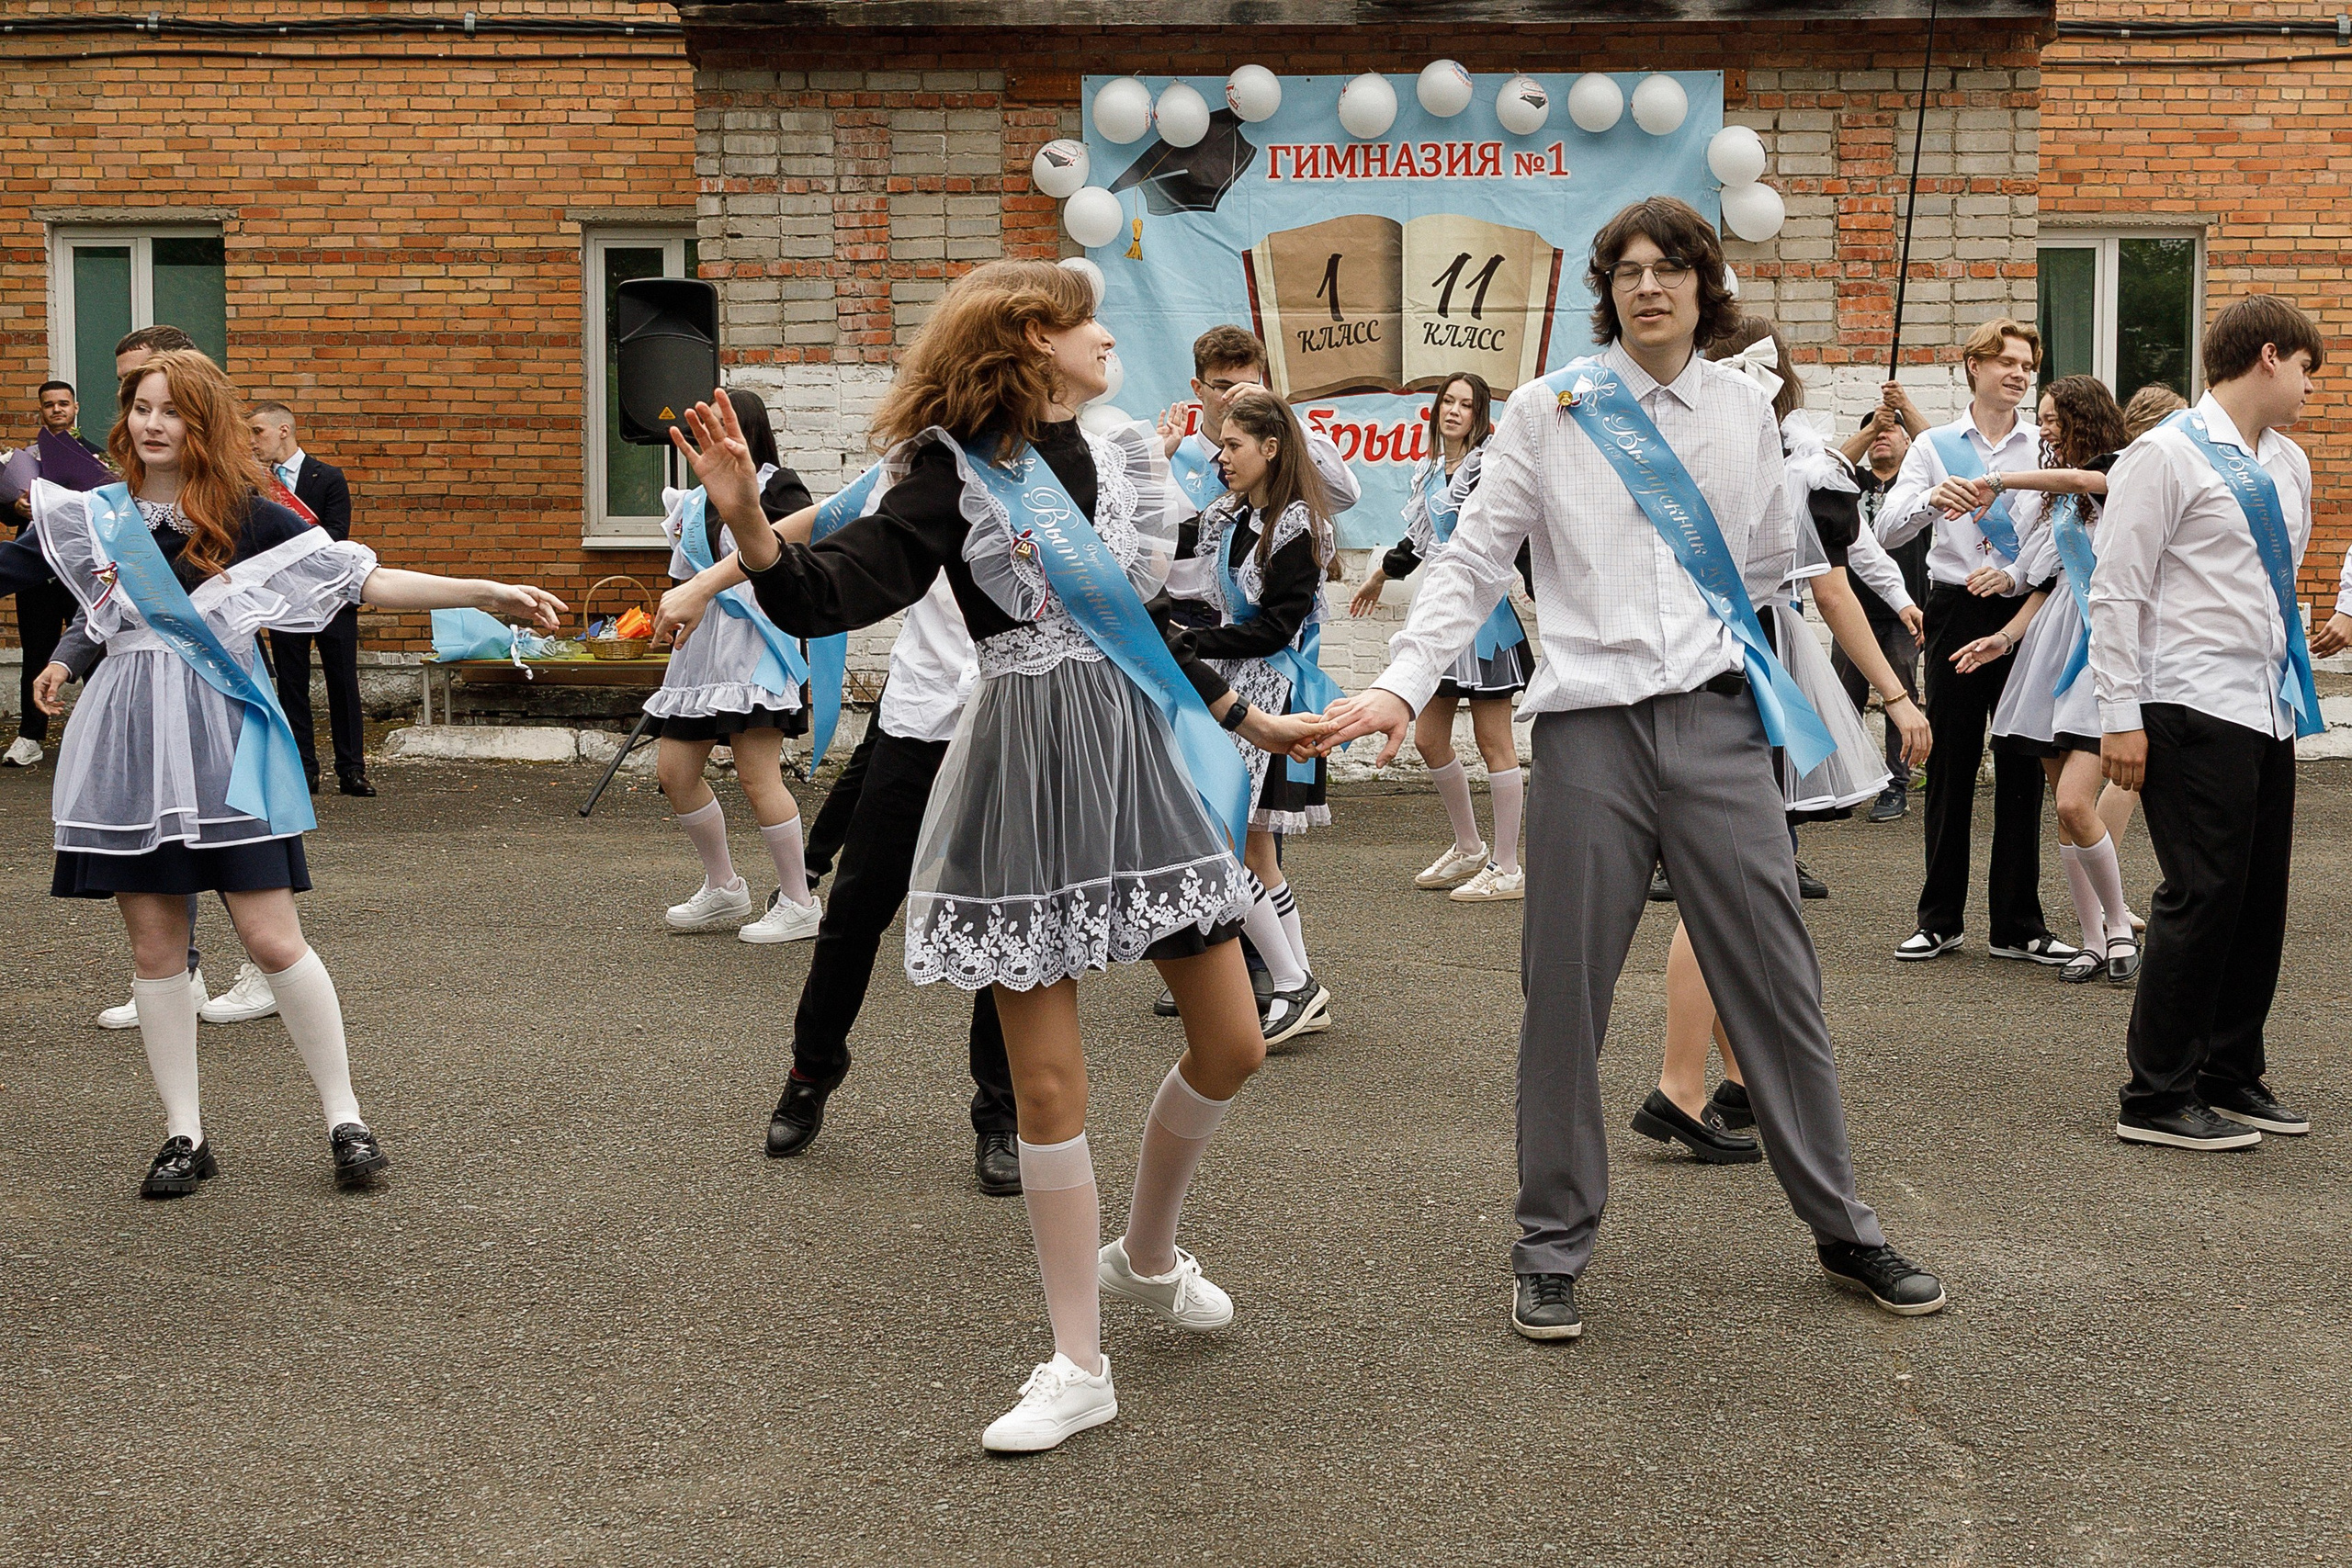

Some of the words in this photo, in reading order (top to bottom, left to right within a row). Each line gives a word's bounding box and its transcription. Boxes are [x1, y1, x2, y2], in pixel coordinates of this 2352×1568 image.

[1268, 141, 1503, 179] ГИМНАЗИЯ
[1513, 141, 1568, 175] №1
[1316, 253, 1344, 321] 1
[1431, 252, 1506, 321] 11
[1296, 320, 1382, 354] КЛАСС
[1423, 321, 1506, 352] КЛАСС
[1602, 410, 1708, 556] Выпускник
